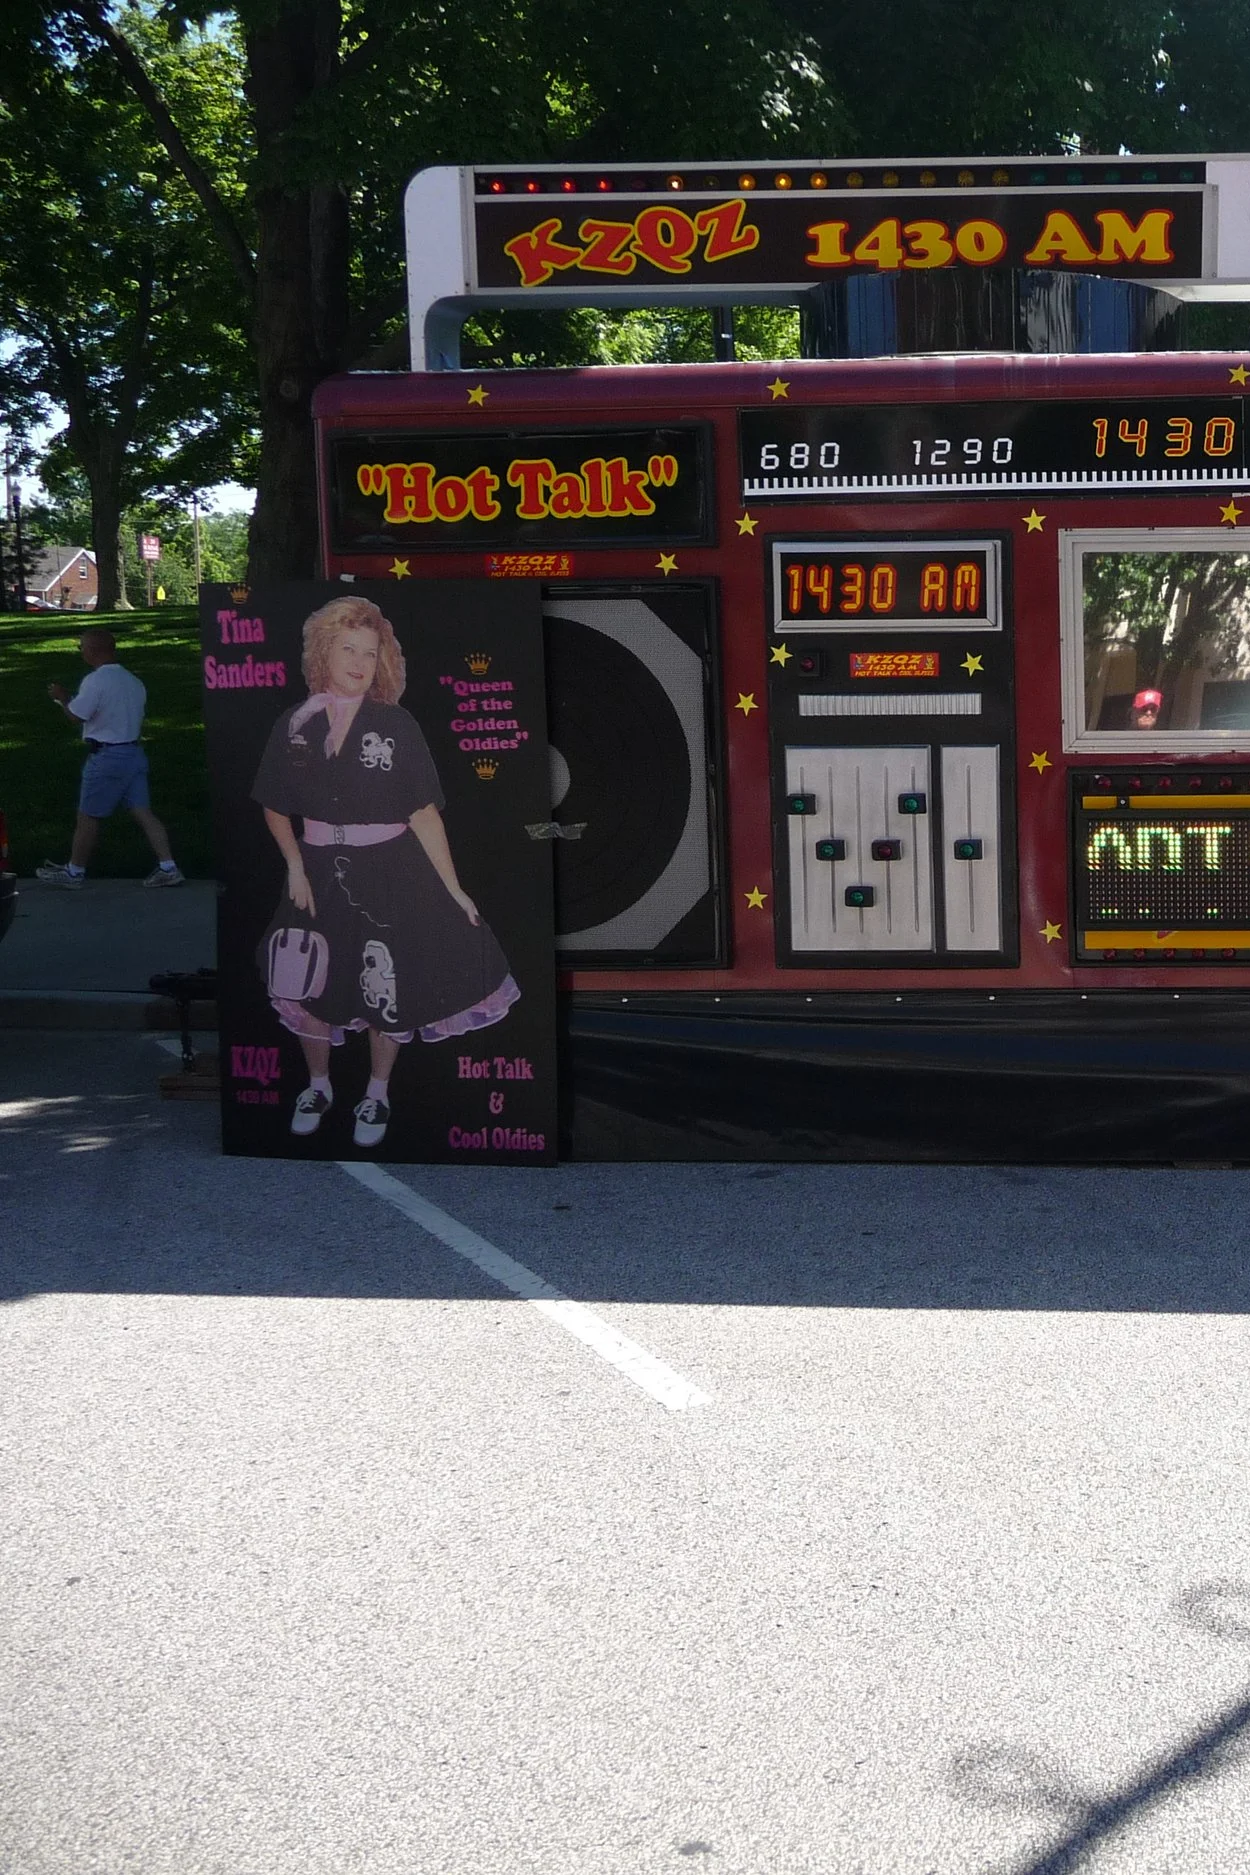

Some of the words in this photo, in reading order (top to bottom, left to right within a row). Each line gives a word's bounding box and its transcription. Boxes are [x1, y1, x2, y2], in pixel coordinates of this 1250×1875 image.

[504, 199, 760, 287] KZQZ
[805, 218, 1006, 269] 1430
[1024, 208, 1175, 265] AM
[1092, 416, 1235, 458] 1430
[760, 443, 841, 470] 680
[912, 437, 1013, 467] 1290
[356, 459, 502, 524] "Hot
[507, 455, 679, 521] Talk"
[501, 555, 557, 566] KZQZ
[786, 563, 896, 613] 1430
[920, 563, 981, 612] AM
[216, 609, 265, 644] Tina
[203, 655, 287, 690] Sanders
[865, 655, 923, 665] KZQZ
[439, 676, 514, 695] "Queen
[457, 699, 478, 712] of
[481, 697, 513, 711] the
[450, 717, 519, 732] Golden
[458, 731, 529, 751] Oldies"
[231, 1046, 281, 1086] KZQZ
[457, 1057, 490, 1080] Hot
[494, 1057, 534, 1080] Talk
[489, 1092, 504, 1114] &
[449, 1128, 488, 1149] Cool
[492, 1127, 545, 1151] Oldies
